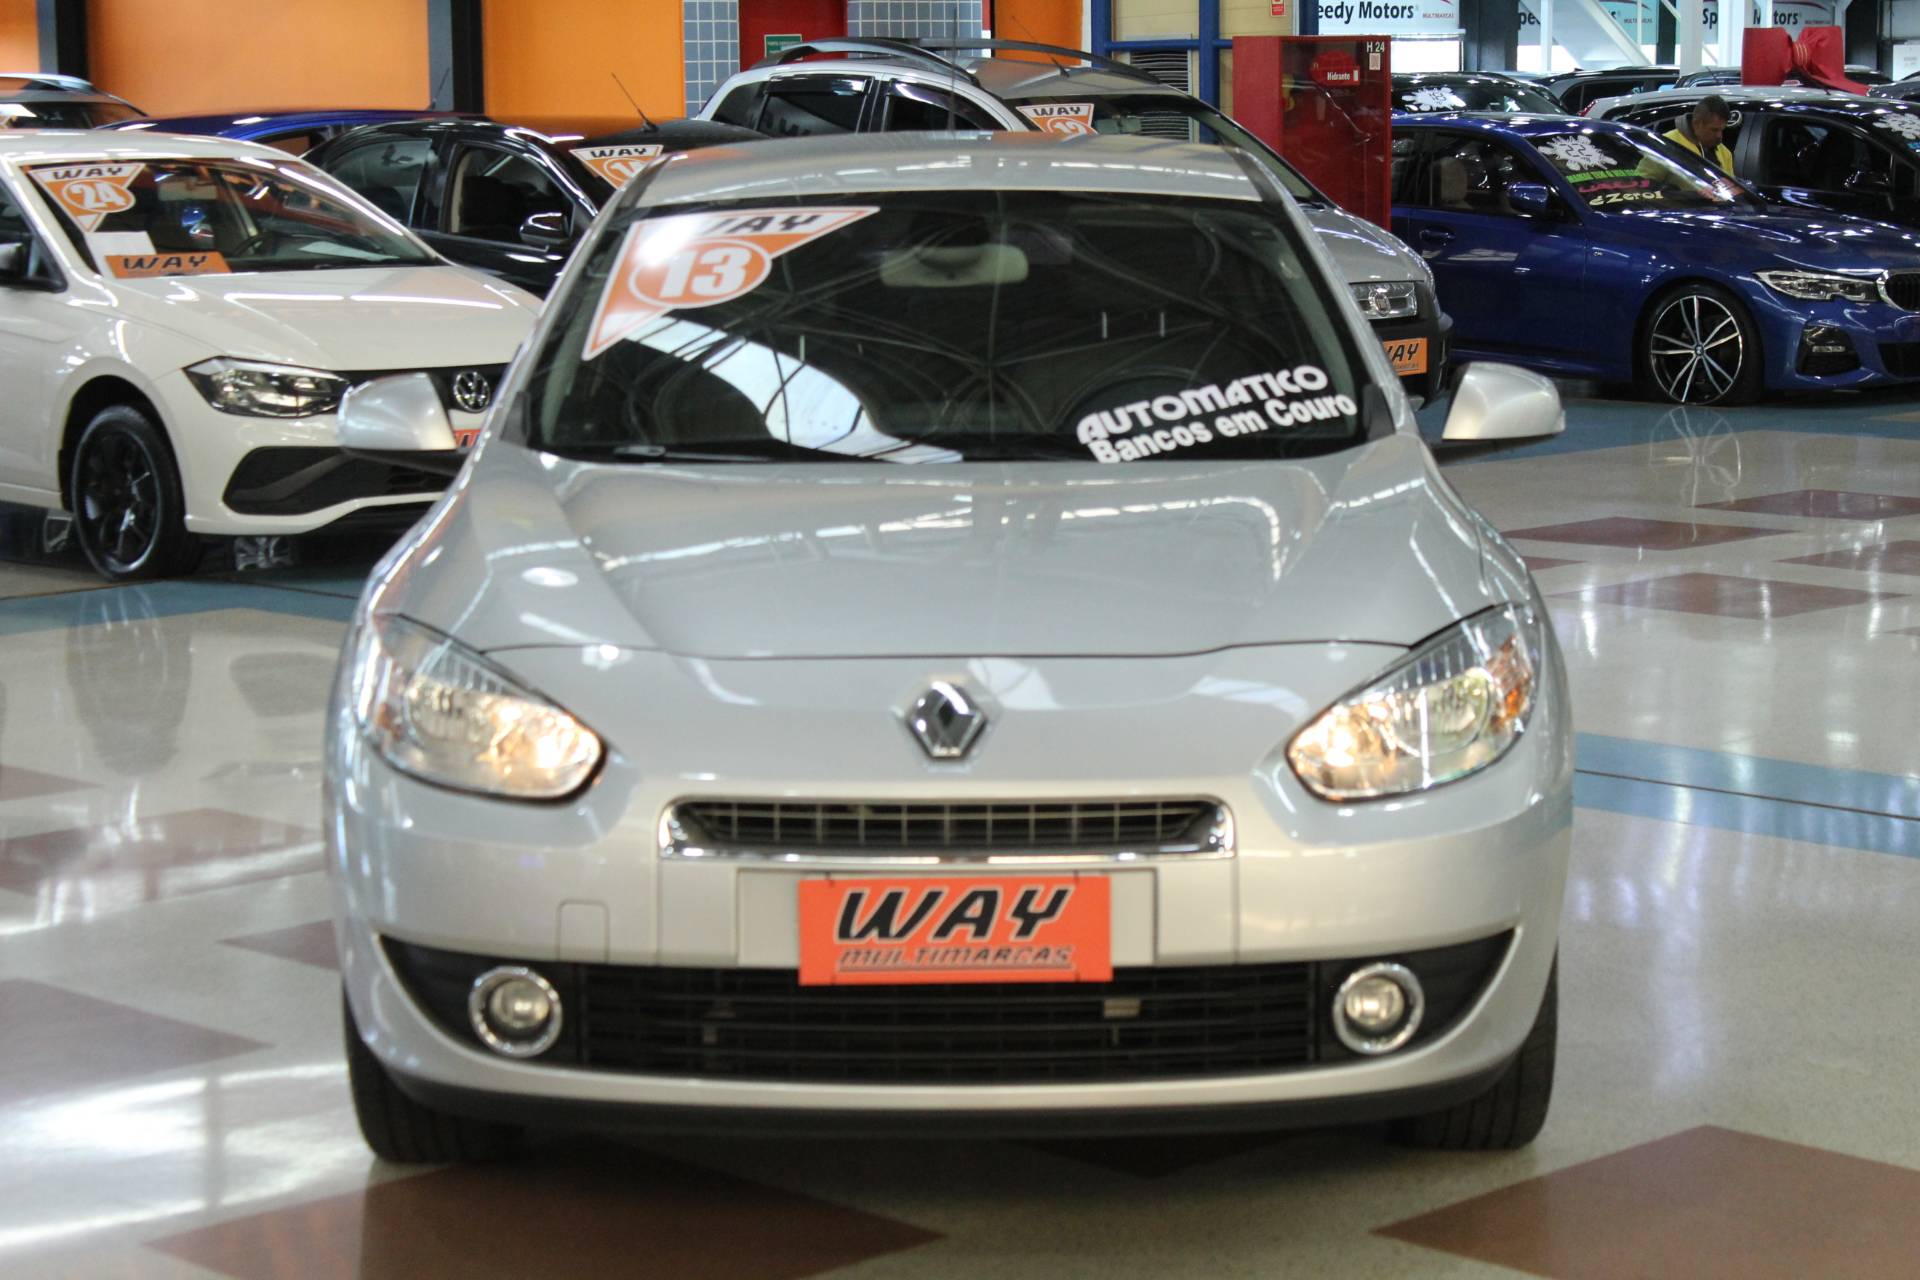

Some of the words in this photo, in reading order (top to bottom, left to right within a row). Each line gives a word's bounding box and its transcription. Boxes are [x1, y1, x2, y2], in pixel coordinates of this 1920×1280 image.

[1358, 1, 1414, 19] Motors
[1366, 41, 1373, 52] H
[1375, 41, 1385, 52] 24
[1033, 106, 1081, 116] WAY
[590, 147, 647, 158] WAY
[53, 166, 123, 180] WAY
[68, 181, 129, 209] 24
[123, 255, 208, 269] WAY
[658, 246, 751, 297] 13
[1387, 343, 1419, 362] AY
[1077, 365, 1328, 444] AUTOMATICO
[1088, 421, 1214, 464] Bancos
[1214, 408, 1269, 437] em
[1264, 394, 1358, 427] Couro
[835, 885, 1074, 943] WAY
[838, 945, 1075, 966] MULTIMARCAS
